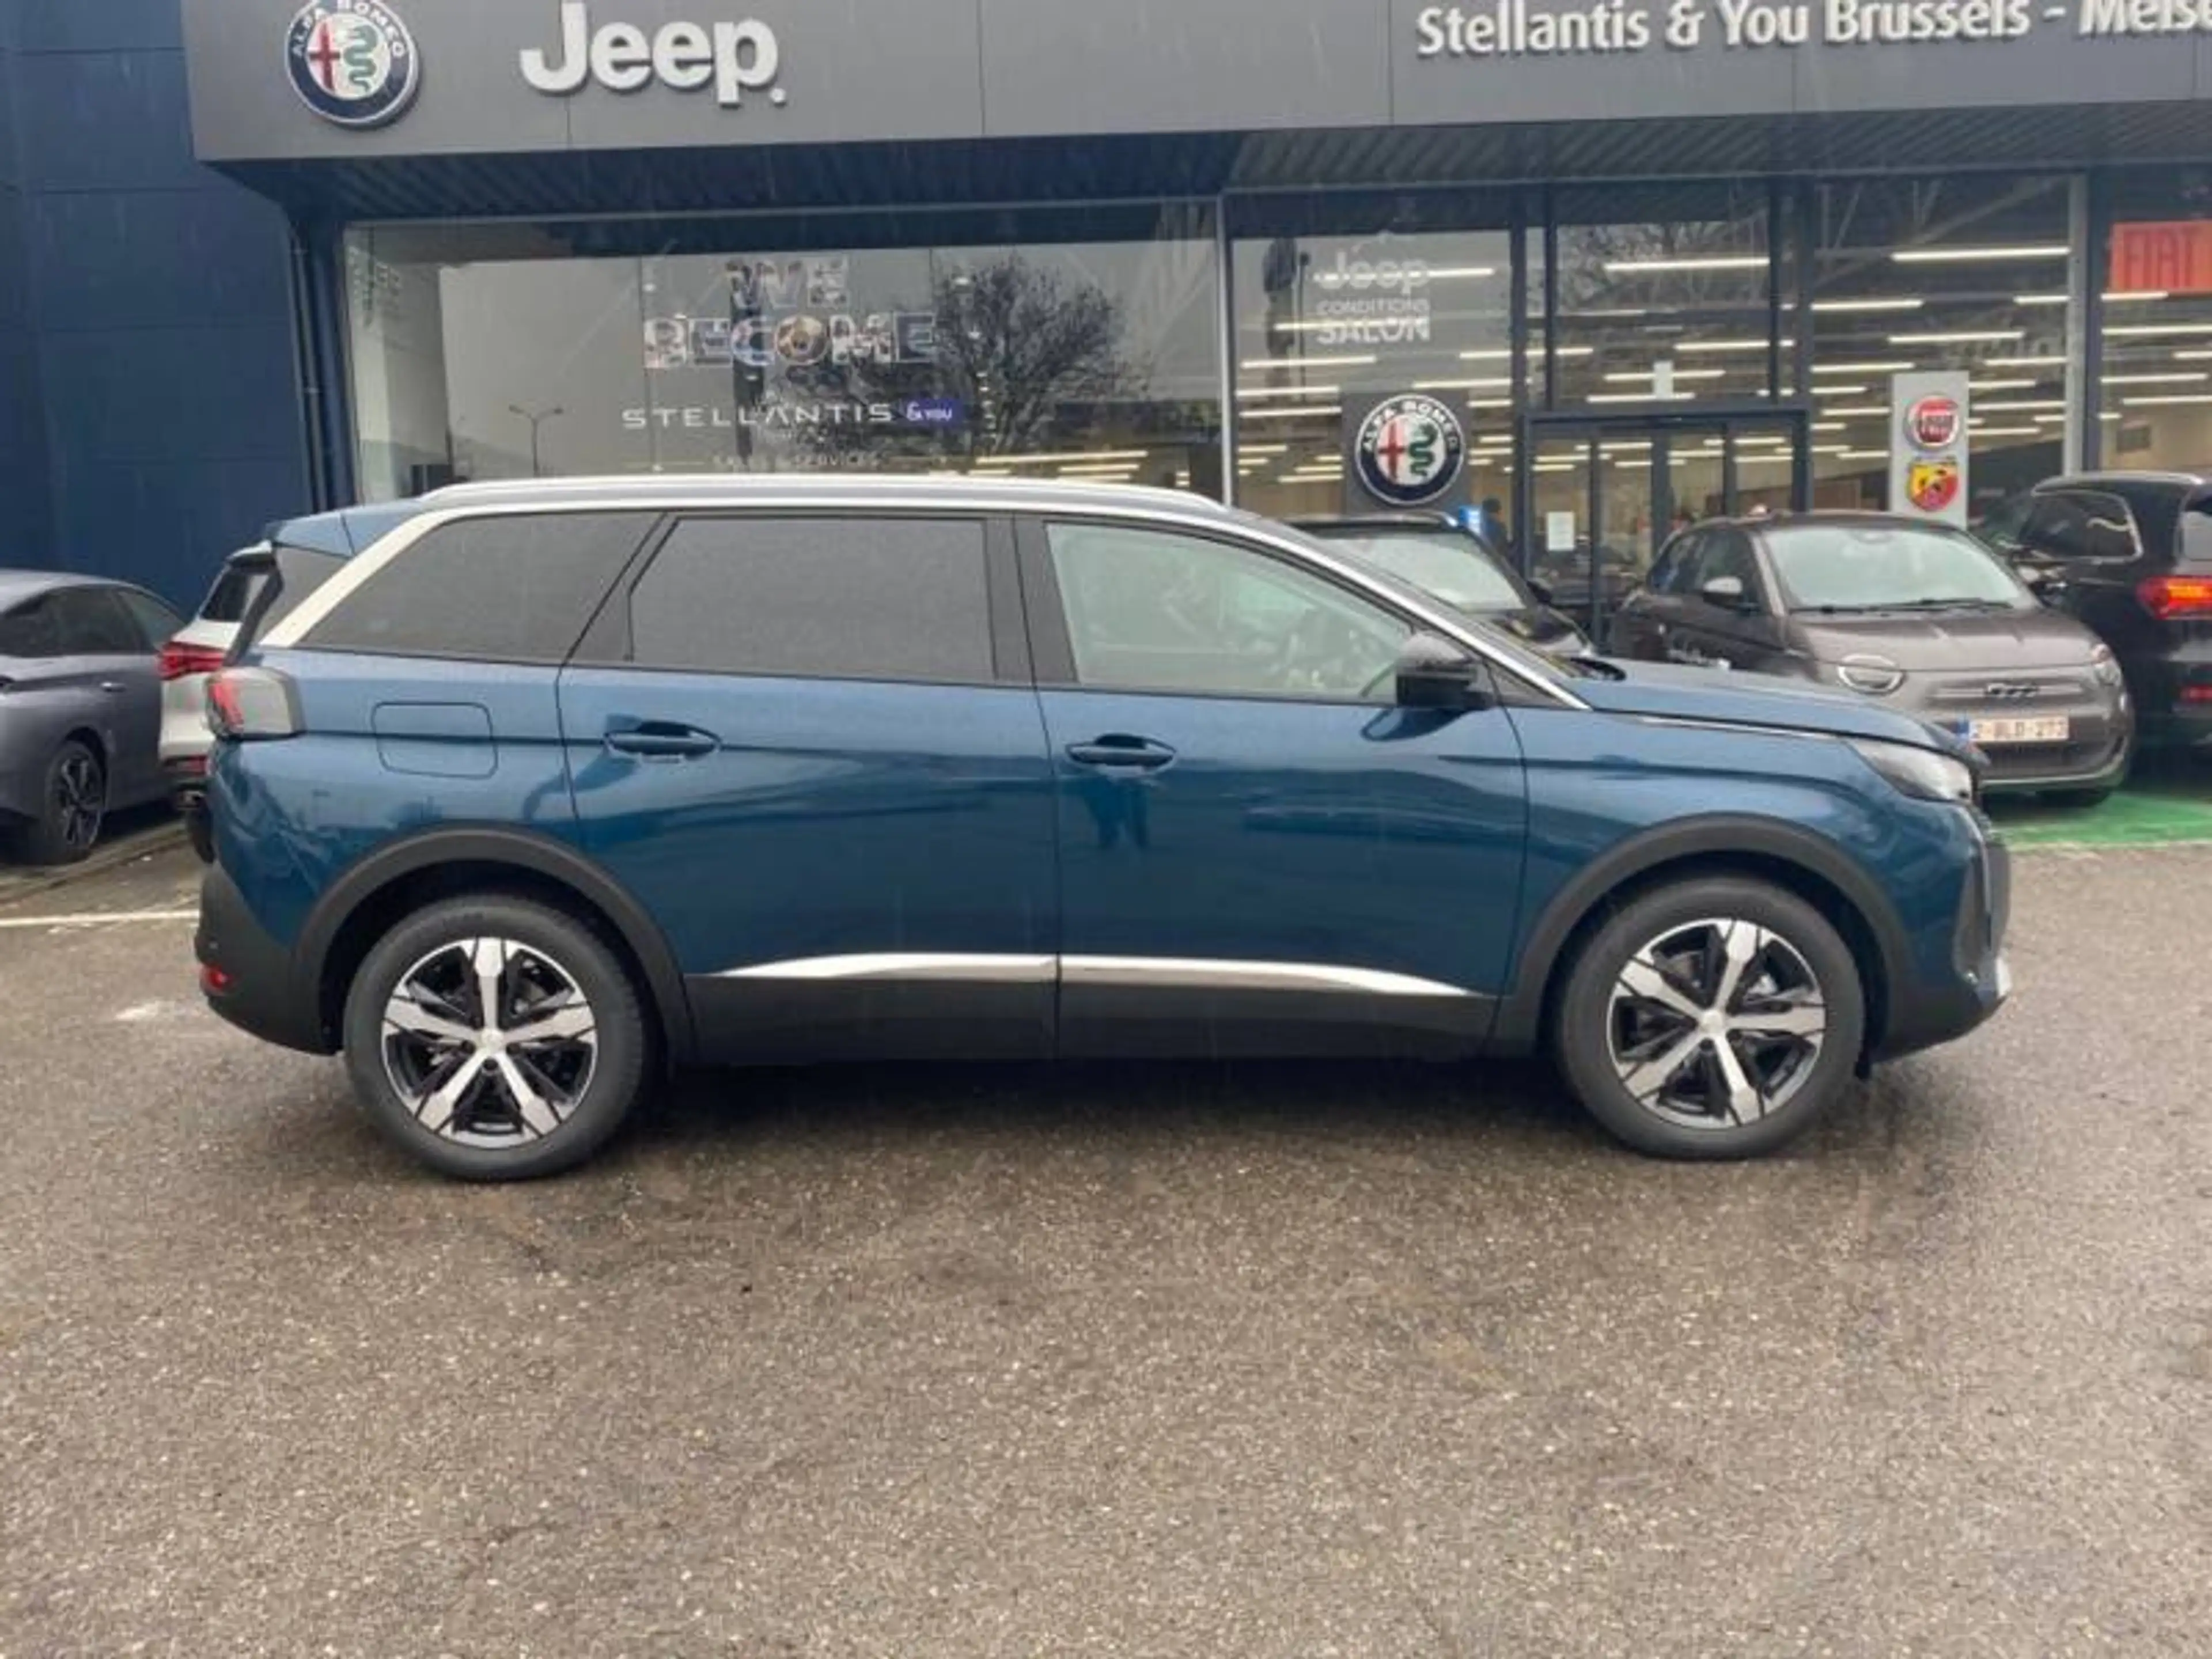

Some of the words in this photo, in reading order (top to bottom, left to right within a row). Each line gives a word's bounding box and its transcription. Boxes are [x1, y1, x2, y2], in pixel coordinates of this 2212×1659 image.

[1418, 0, 1649, 55] Stellantis
[1667, 0, 1705, 46] &
[1715, 0, 1810, 45] You
[1826, 0, 2031, 44] Brussels
[1316, 251, 1429, 295] Jeep
[2122, 224, 2202, 290] FIAT
[1317, 317, 1431, 343] SALON
[622, 403, 893, 430] STELLANTIS
